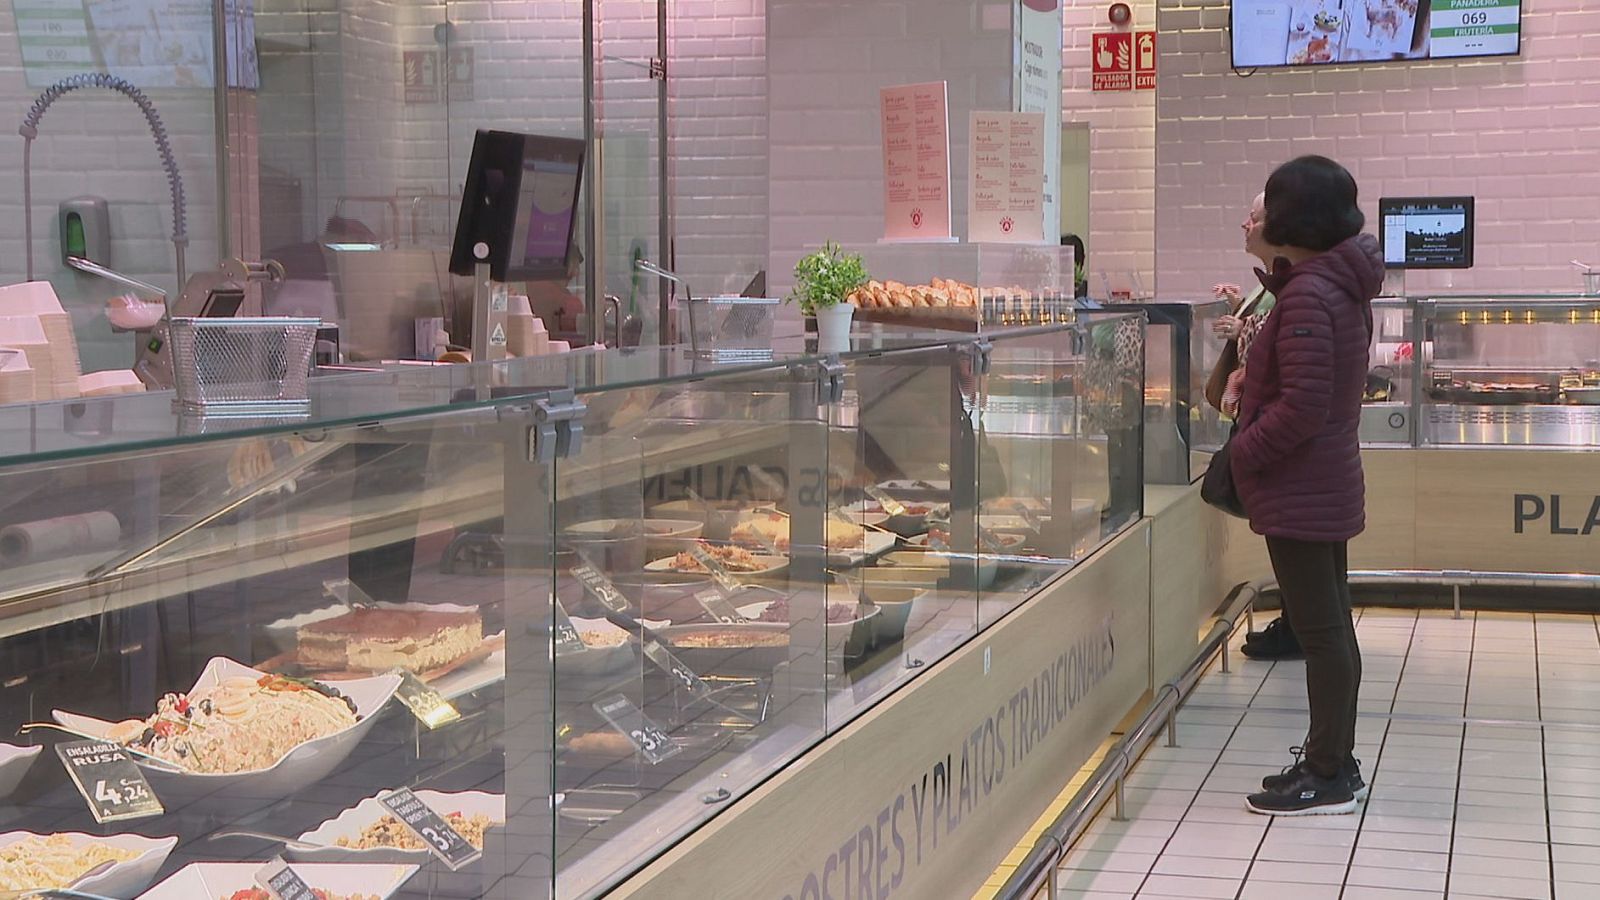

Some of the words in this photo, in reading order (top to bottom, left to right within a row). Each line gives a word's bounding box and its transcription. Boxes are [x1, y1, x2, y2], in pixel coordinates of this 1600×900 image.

[1461, 12, 1487, 25] 069
[1454, 25, 1495, 37] FRUTERÍA
[1095, 74, 1129, 82] PULSADOR
[1137, 76, 1156, 86] EXTI
[1104, 81, 1130, 89] ALARMA
[66, 743, 121, 757] ENSALADILLA
[911, 772, 928, 866] Y
[933, 705, 1007, 850] PLATOS
[1009, 627, 1115, 770] TRADICIONALES
[72, 752, 126, 766] RUSA
[95, 780, 149, 805] 4,24
